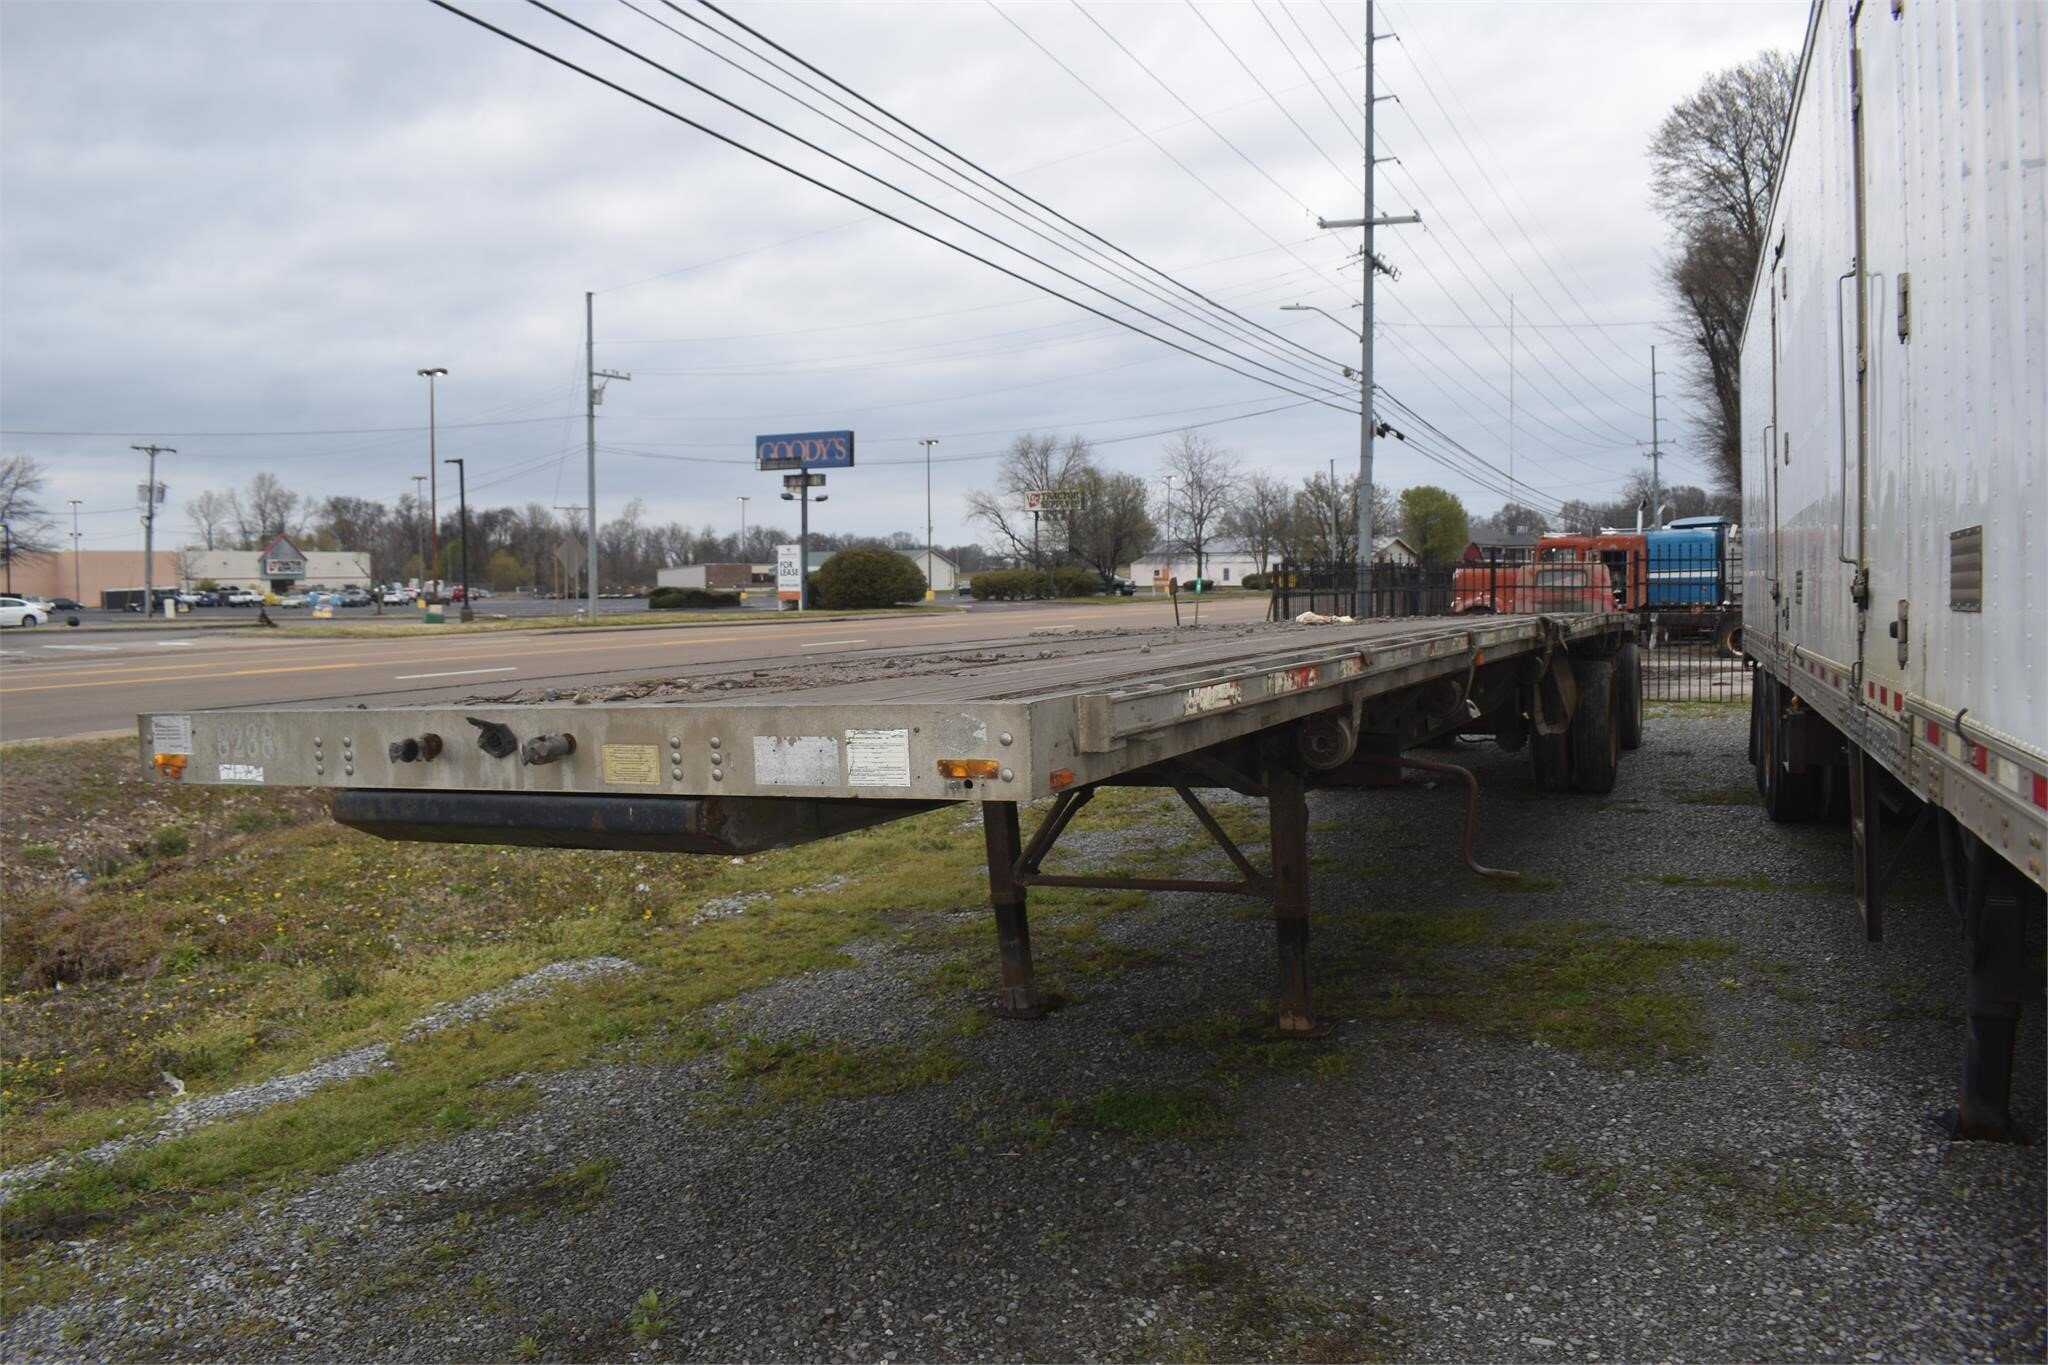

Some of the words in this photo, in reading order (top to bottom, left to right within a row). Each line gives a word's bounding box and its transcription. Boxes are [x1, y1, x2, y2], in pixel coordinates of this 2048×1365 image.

[759, 438, 846, 461] GOODY'S
[780, 560, 792, 568] FOR
[780, 568, 799, 576] LEASE
